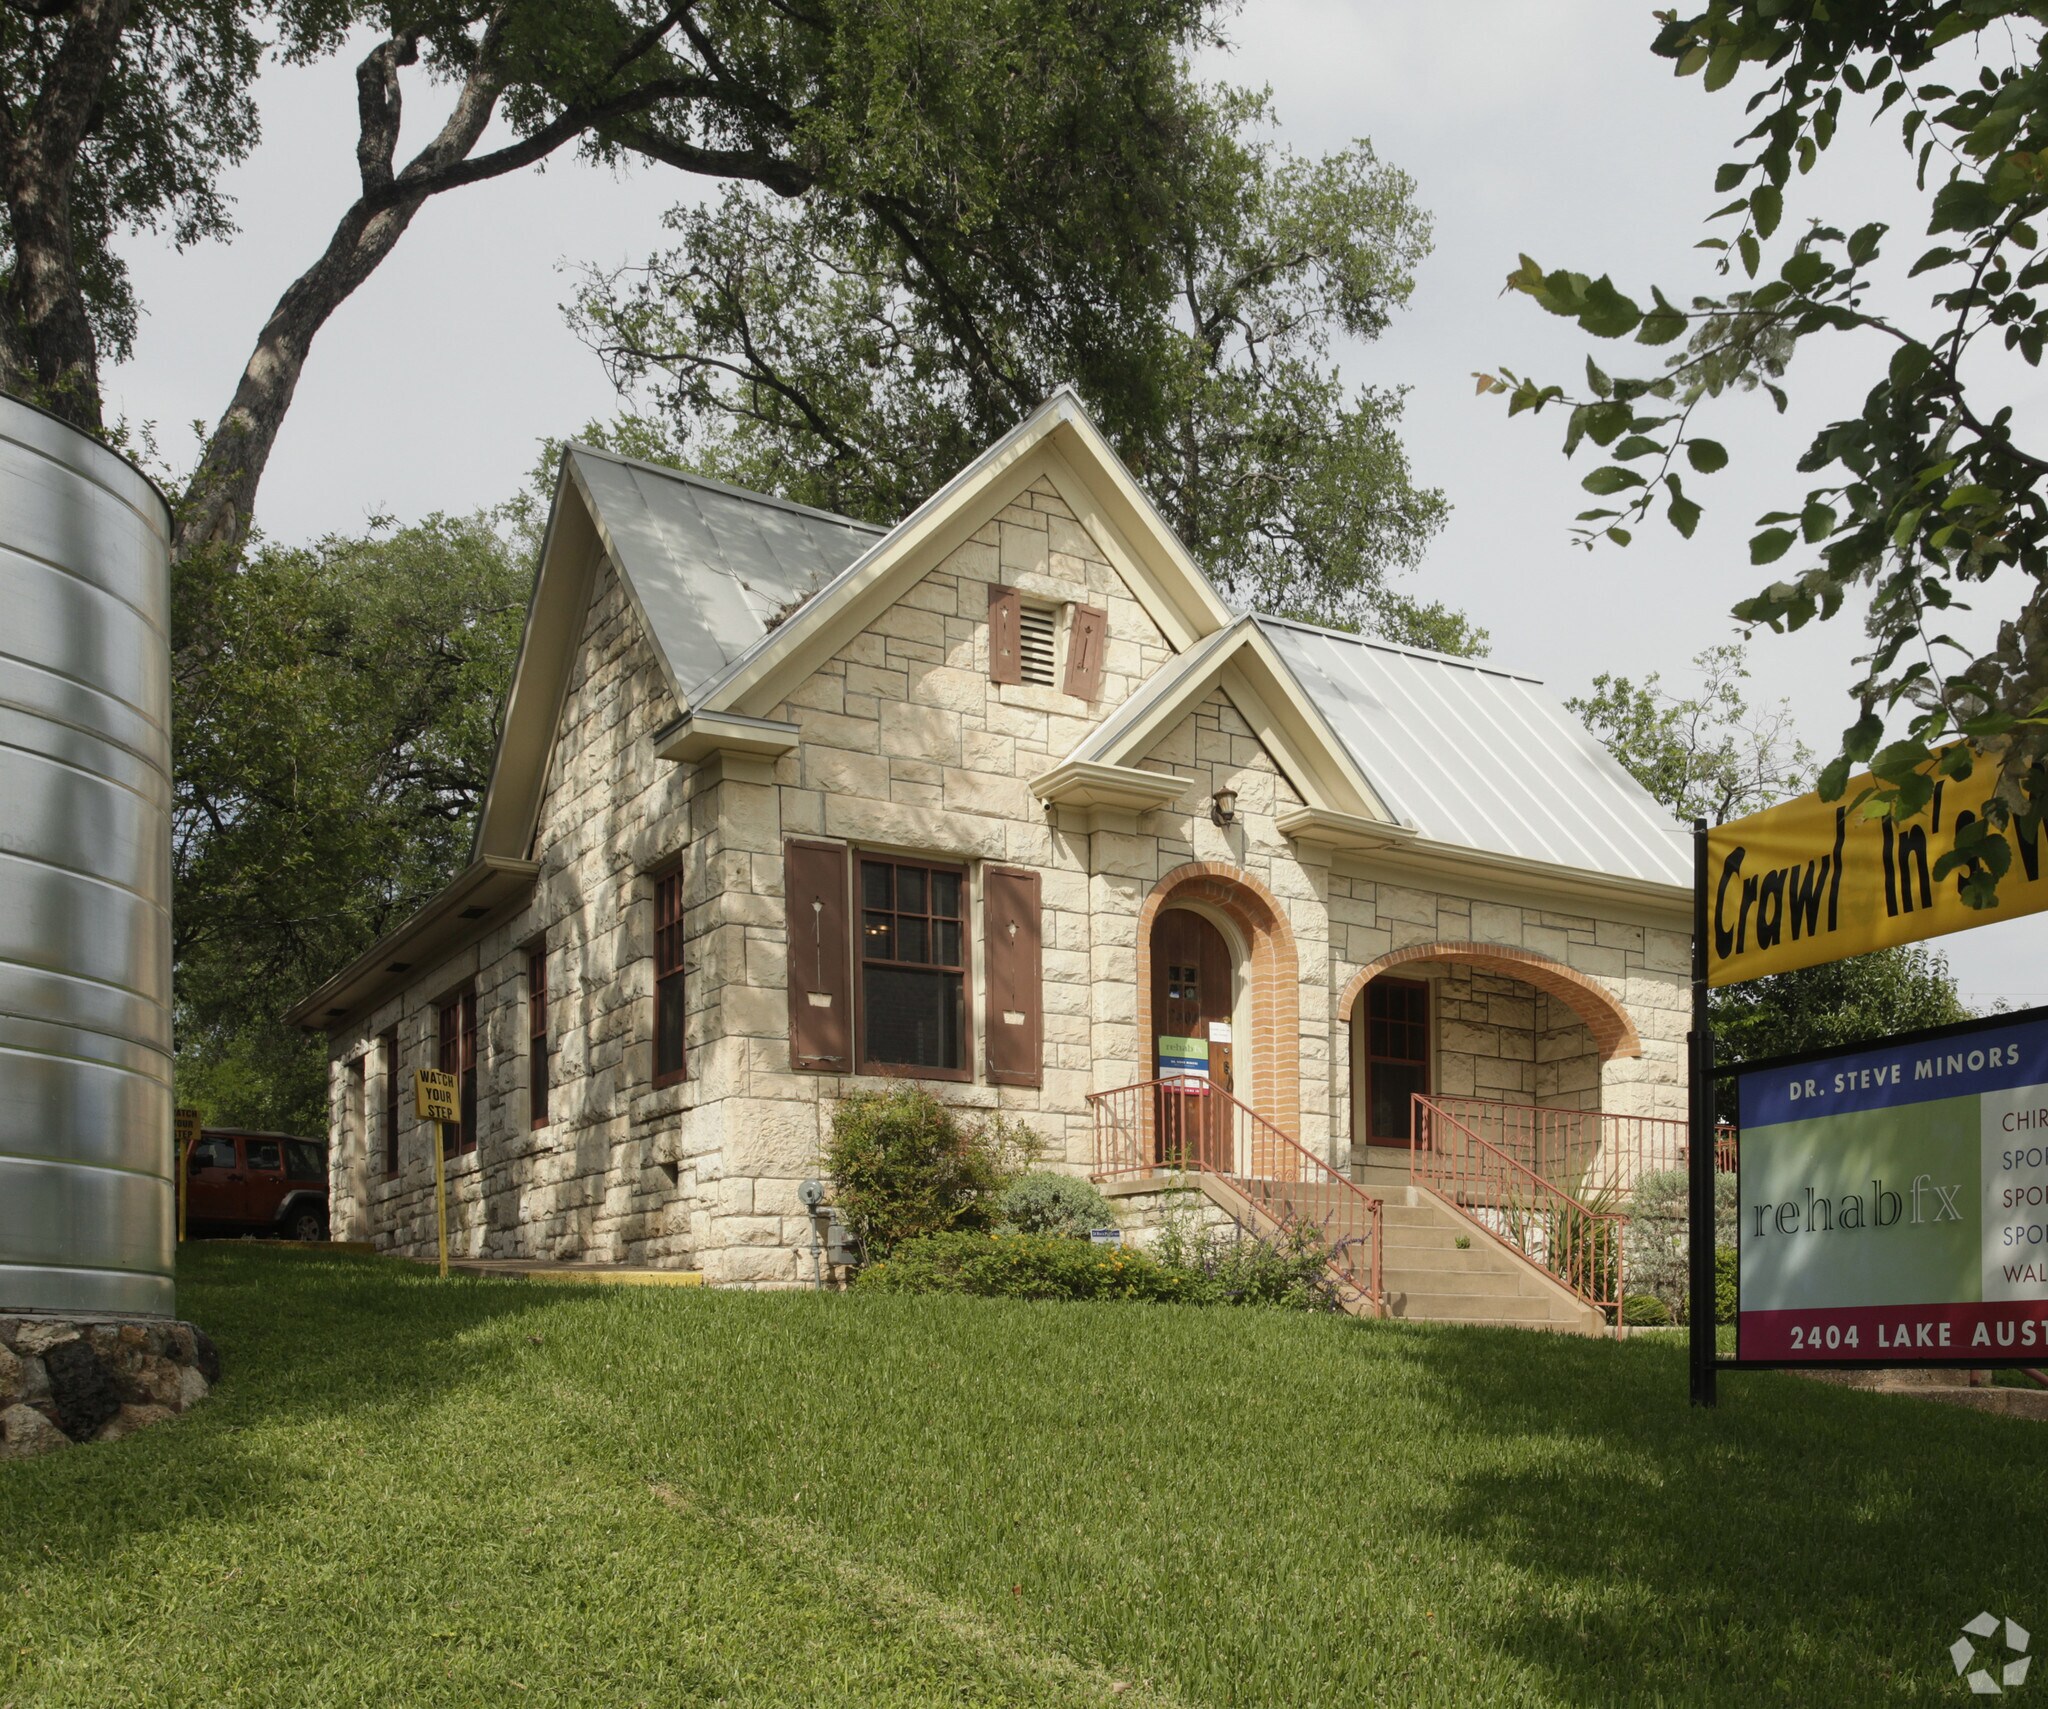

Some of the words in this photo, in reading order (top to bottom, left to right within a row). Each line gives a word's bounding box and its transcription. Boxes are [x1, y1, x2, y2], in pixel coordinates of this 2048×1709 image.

[1714, 805, 1846, 960] Crawl
[420, 1070, 454, 1088] WATCH
[1789, 1079, 1825, 1101] DR.
[1834, 1064, 1901, 1094] STEVE
[1914, 1043, 2020, 1081] MINORS
[426, 1087, 452, 1103] YOUR
[174, 1109, 198, 1118] ATCH
[428, 1104, 453, 1119] STEP
[174, 1119, 194, 1129] OUR
[2002, 1147, 2048, 1171] SPO
[1753, 1174, 1964, 1238] rehabfx
[2003, 1185, 2048, 1208] SPO
[2003, 1224, 2048, 1247] SPO
[1790, 1325, 1860, 1350] 2404
[1878, 1322, 1951, 1348] LAKE
